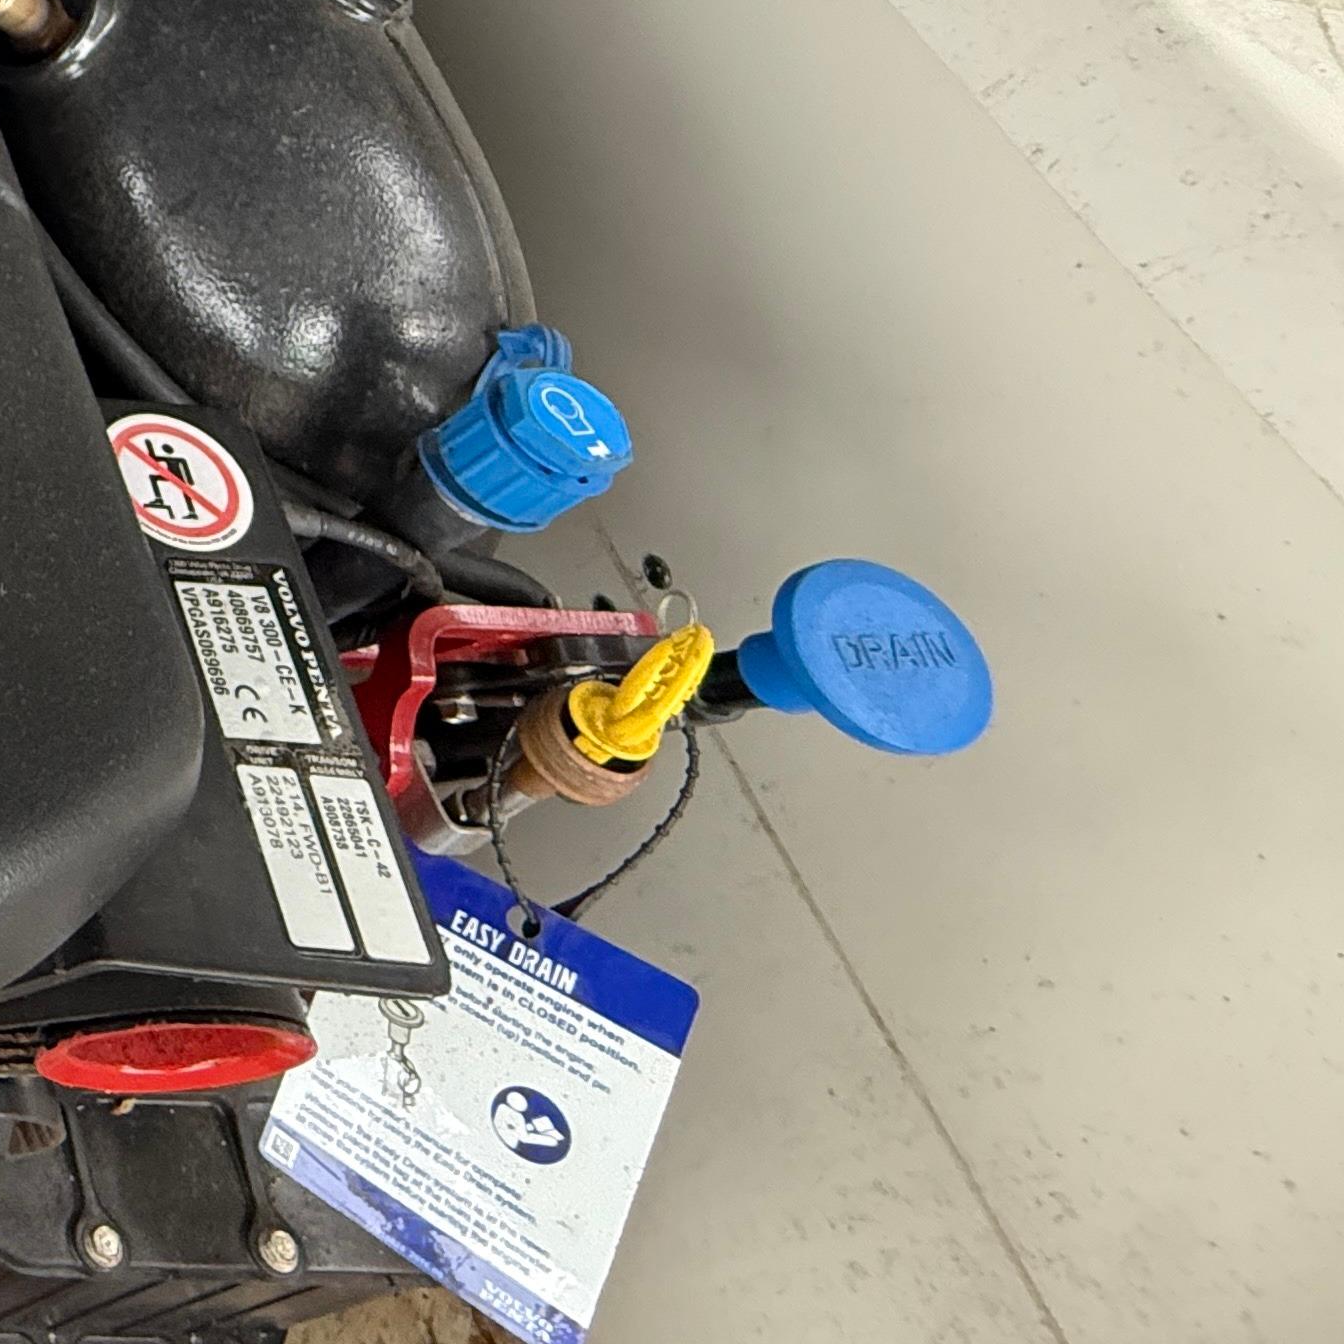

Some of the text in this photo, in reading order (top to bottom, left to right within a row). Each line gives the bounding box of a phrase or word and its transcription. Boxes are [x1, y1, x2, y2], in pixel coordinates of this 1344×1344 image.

[181, 587, 230, 696] VPGAS069696
[203, 587, 238, 654] A916275
[227, 589, 265, 663] 40869757
[251, 595, 271, 614] V8
[272, 568, 342, 740] VOLVO PENTA
[832, 630, 958, 674] DRAIN
[248, 773, 284, 849] A913078
[266, 775, 303, 859] 22492123
[450, 909, 578, 995] EASY DRAIN
[453, 944, 625, 1045] only operate engine when
[502, 985, 515, 1001] in
[518, 996, 578, 1035] CLOSED
